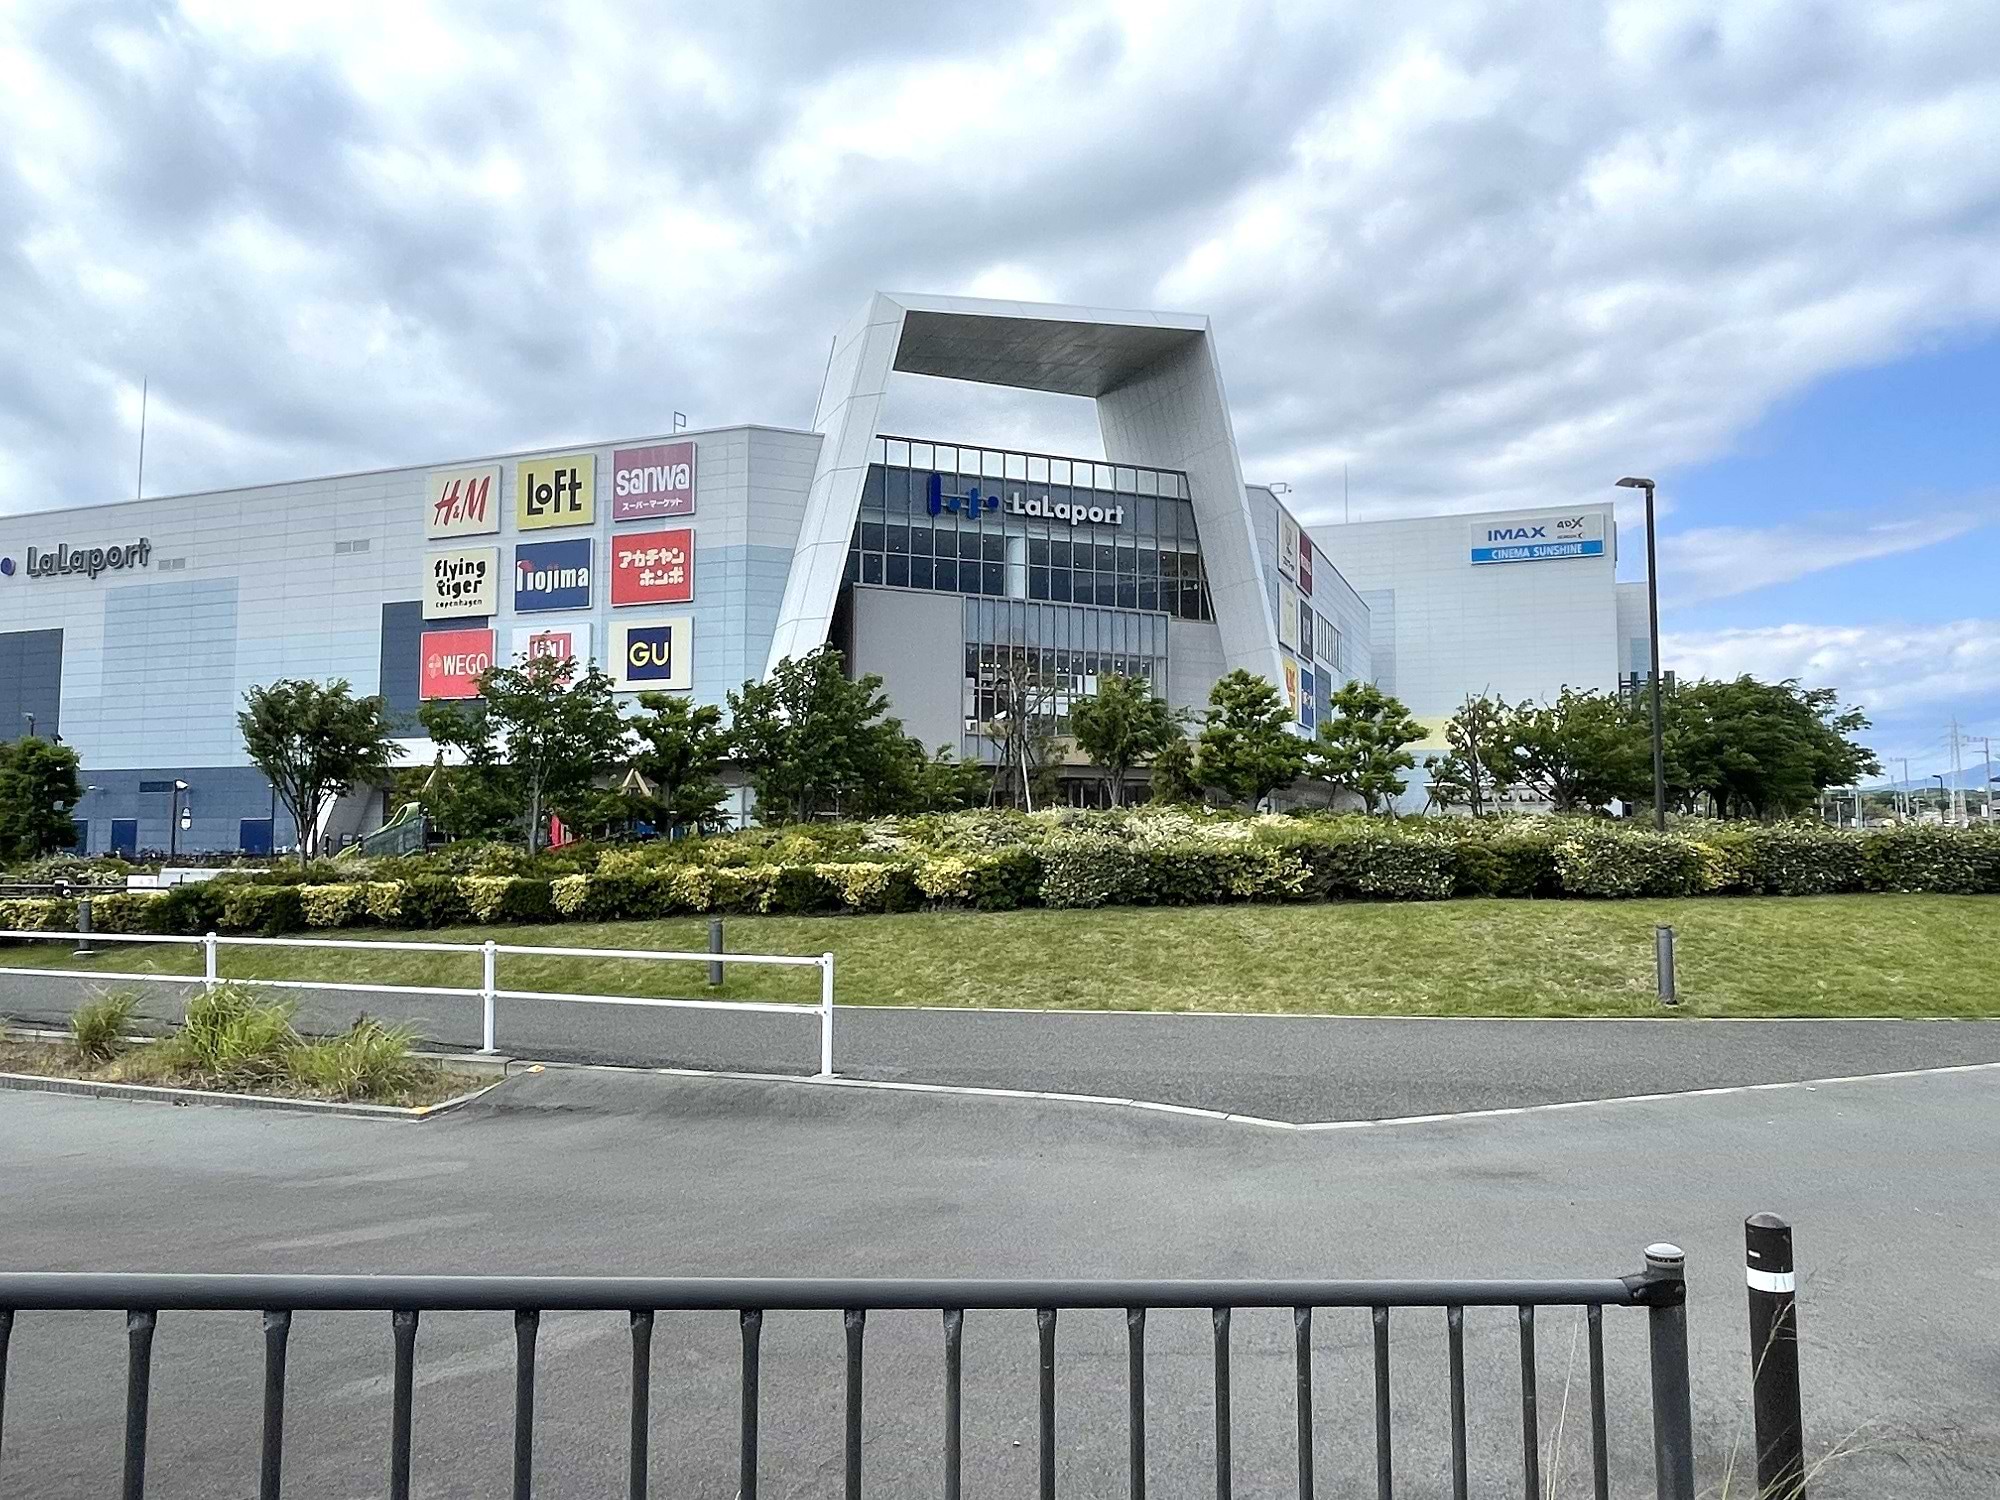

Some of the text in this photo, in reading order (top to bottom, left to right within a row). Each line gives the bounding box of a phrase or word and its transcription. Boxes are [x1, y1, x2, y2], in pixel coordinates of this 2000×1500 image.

[616, 463, 690, 496] sanwa
[434, 476, 490, 526] H&M
[622, 498, 683, 511] スーパーマーケット
[1013, 492, 1124, 525] LaLaport
[1488, 526, 1545, 541] IMAX
[1557, 516, 1585, 529] 4DX
[27, 537, 151, 579] LaLaport
[1491, 544, 1582, 559] CINEMA SUNSHINE
[434, 557, 486, 581] flying
[437, 578, 482, 599] tiger
[435, 599, 483, 609] copenhagen
[443, 653, 489, 675] WEGO
[629, 641, 670, 667] GU
